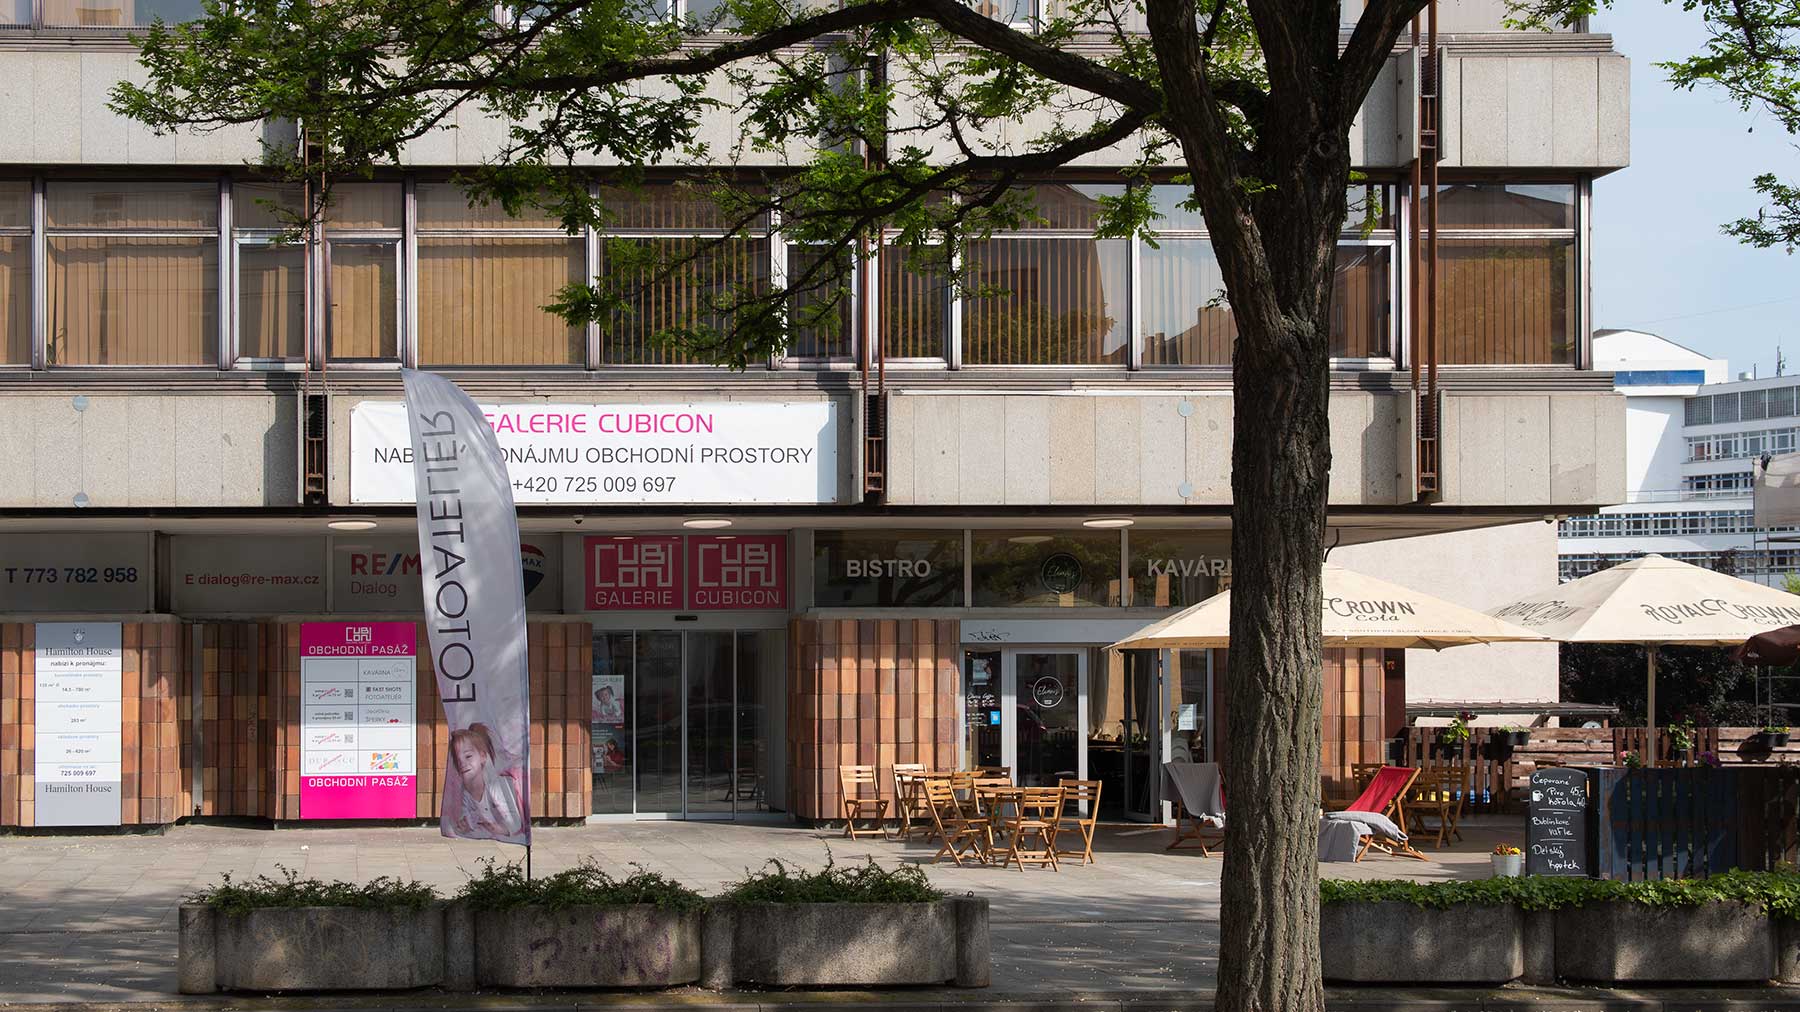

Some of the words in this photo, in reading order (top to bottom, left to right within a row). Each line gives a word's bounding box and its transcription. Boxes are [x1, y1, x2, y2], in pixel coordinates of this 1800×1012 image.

[598, 414, 714, 433] CUBICON
[586, 444, 695, 464] OBCHODNÍ
[701, 447, 812, 464] PROSTORY
[513, 477, 558, 493] +420
[564, 477, 598, 493] 725
[603, 477, 637, 493] 009
[642, 477, 676, 493] 697
[351, 553, 422, 576] RE/M
[846, 558, 932, 578] BISTRO
[1147, 554, 1233, 577] KAVÁR
[5, 567, 18, 583] T
[24, 567, 58, 583] 773
[64, 567, 98, 583] 782
[103, 567, 138, 583] 958
[185, 574, 195, 585] E
[198, 573, 320, 588] dialog@re-max.cz
[351, 581, 397, 597] Dialog
[595, 591, 673, 605] GALERIE
[695, 590, 780, 605] CUBICON
[1355, 614, 1400, 622] Cola
[45, 647, 84, 656] Hamilton
[86, 647, 112, 656] House
[308, 644, 367, 655] OBCHODNÍ
[371, 644, 409, 655] PASÁŽ
[45, 784, 84, 793] Hamilton
[86, 784, 112, 793] House
[308, 777, 367, 787] OBCHODNÍ
[371, 776, 409, 787] PASÁŽ
[1547, 787, 1565, 797] Pivo
